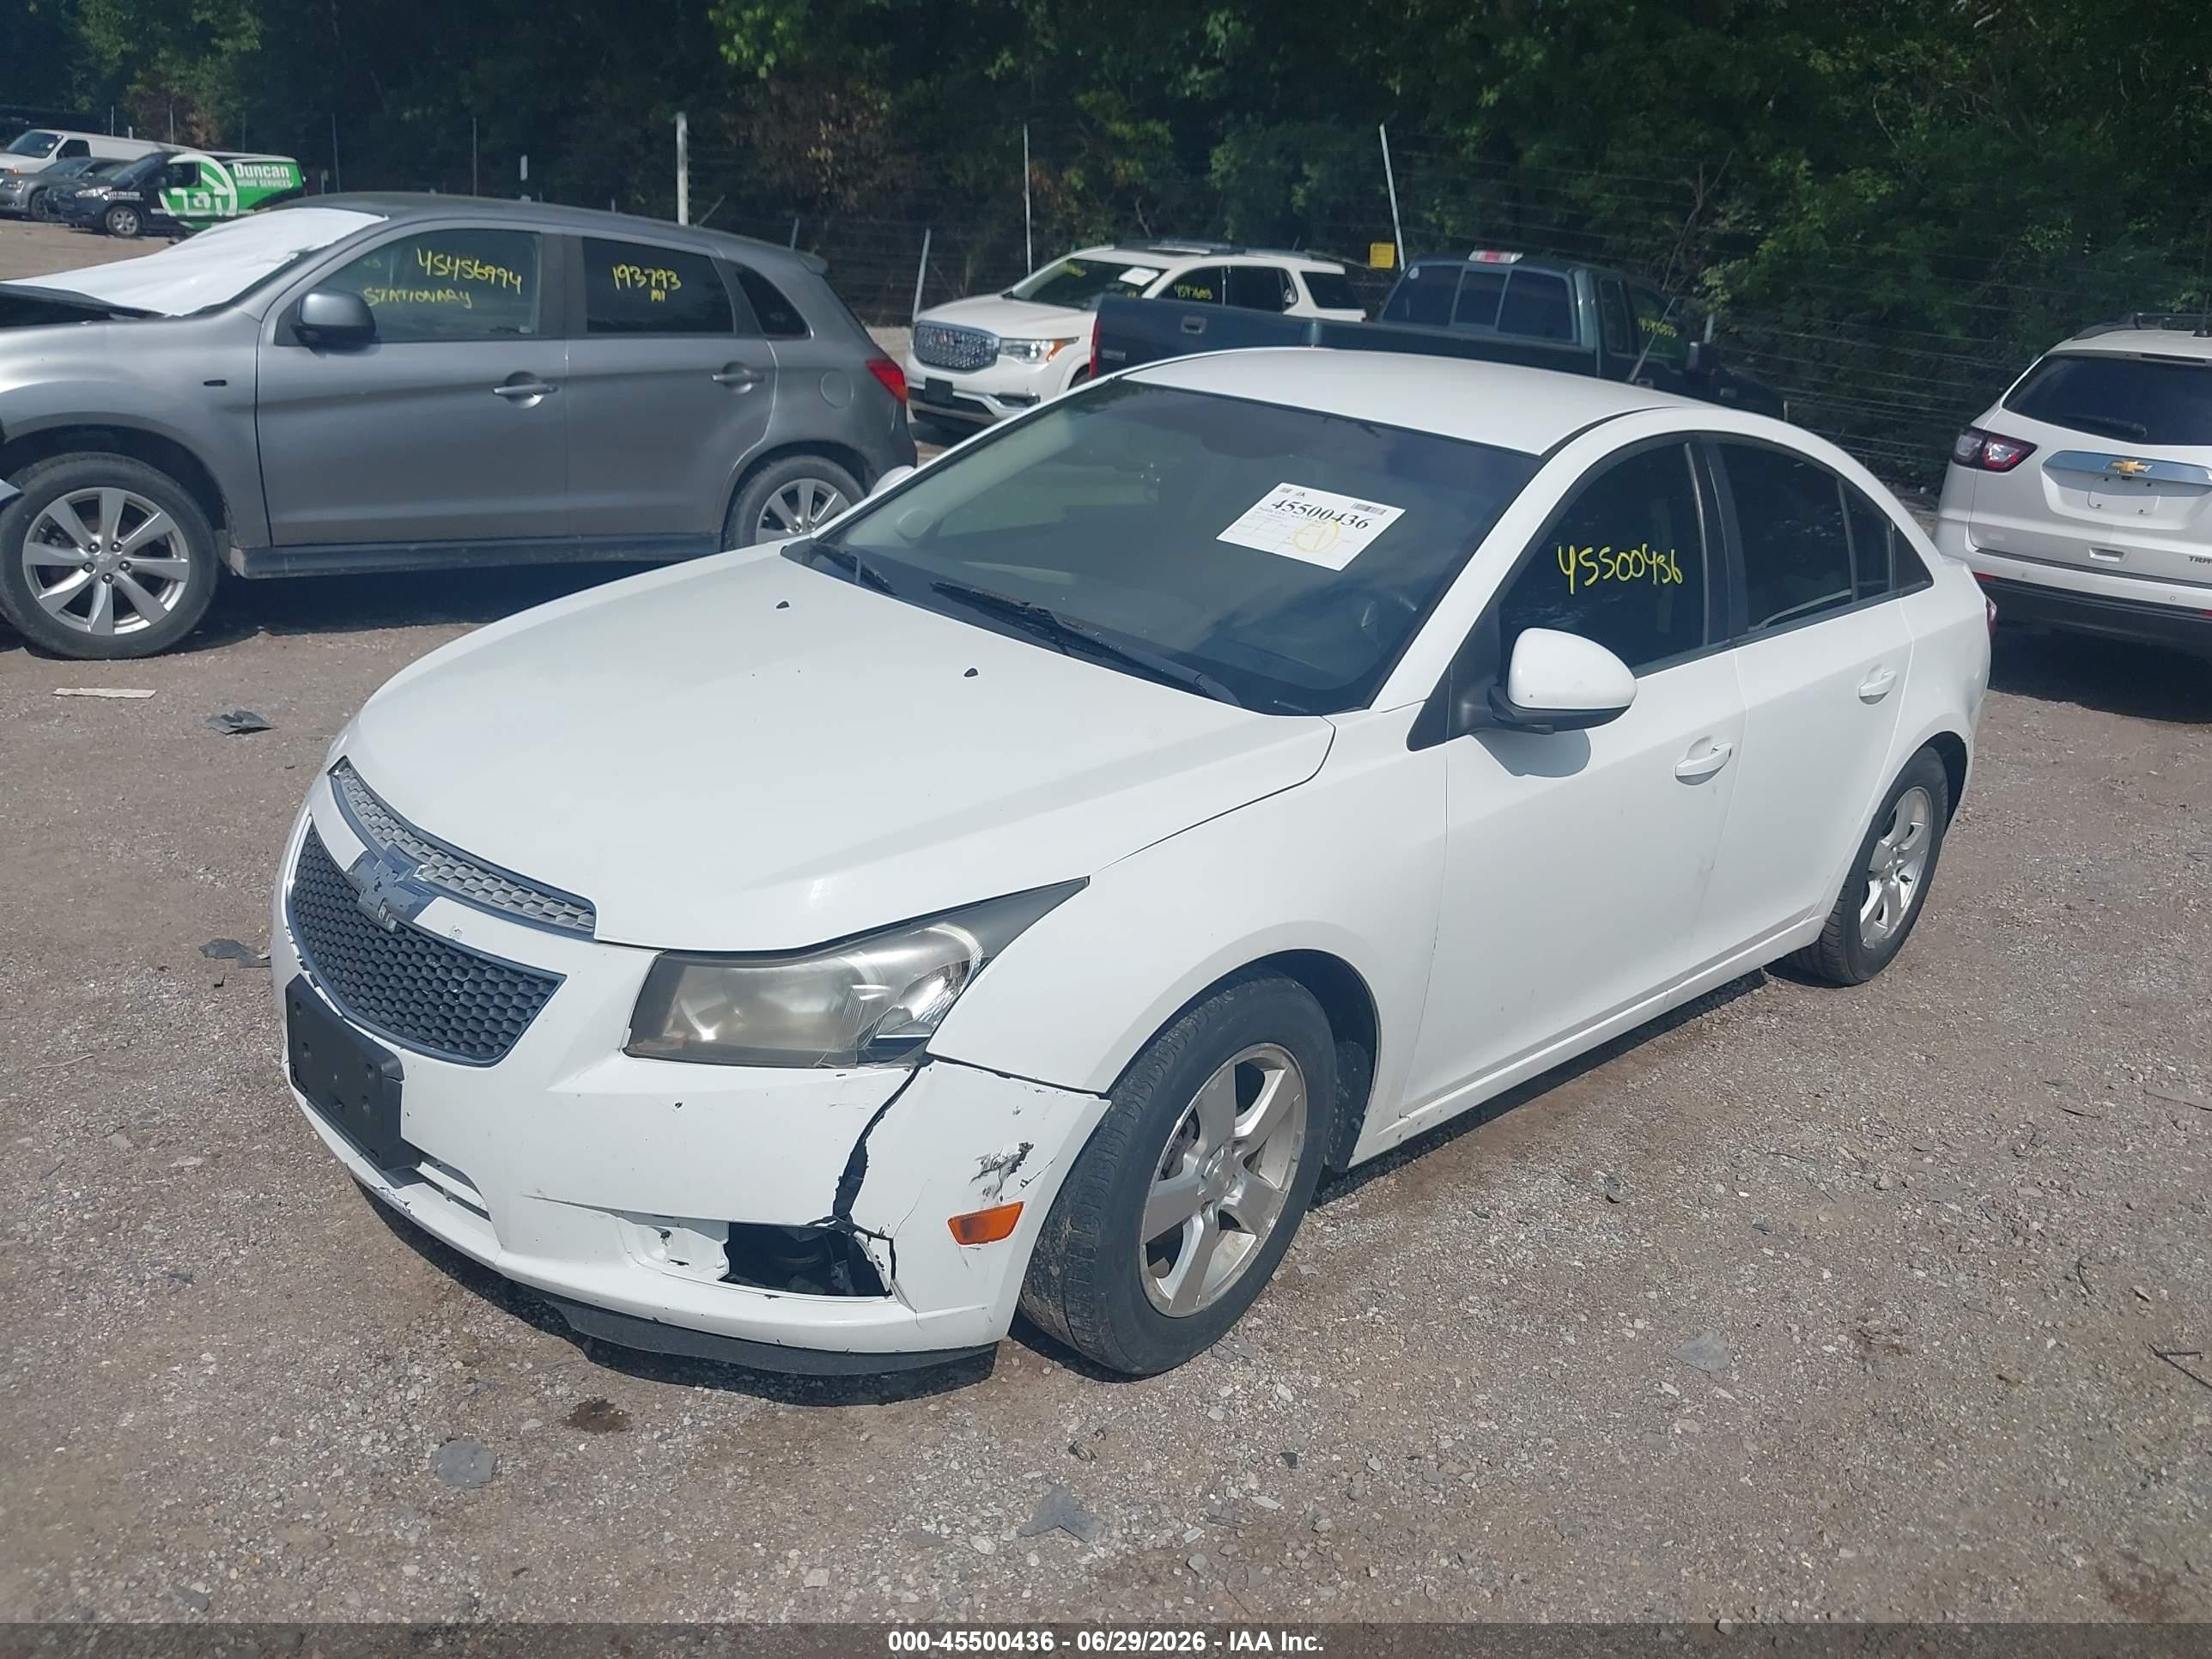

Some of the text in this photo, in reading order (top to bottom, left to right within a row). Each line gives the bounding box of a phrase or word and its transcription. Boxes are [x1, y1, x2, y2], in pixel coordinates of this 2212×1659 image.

[233, 162, 290, 179] Duncan
[612, 263, 682, 291] 193793
[363, 287, 472, 309] STATIONARY
[1271, 498, 1375, 531] 45500436
[1558, 543, 1683, 595] 45500436
[2189, 556, 2212, 564] TRA
